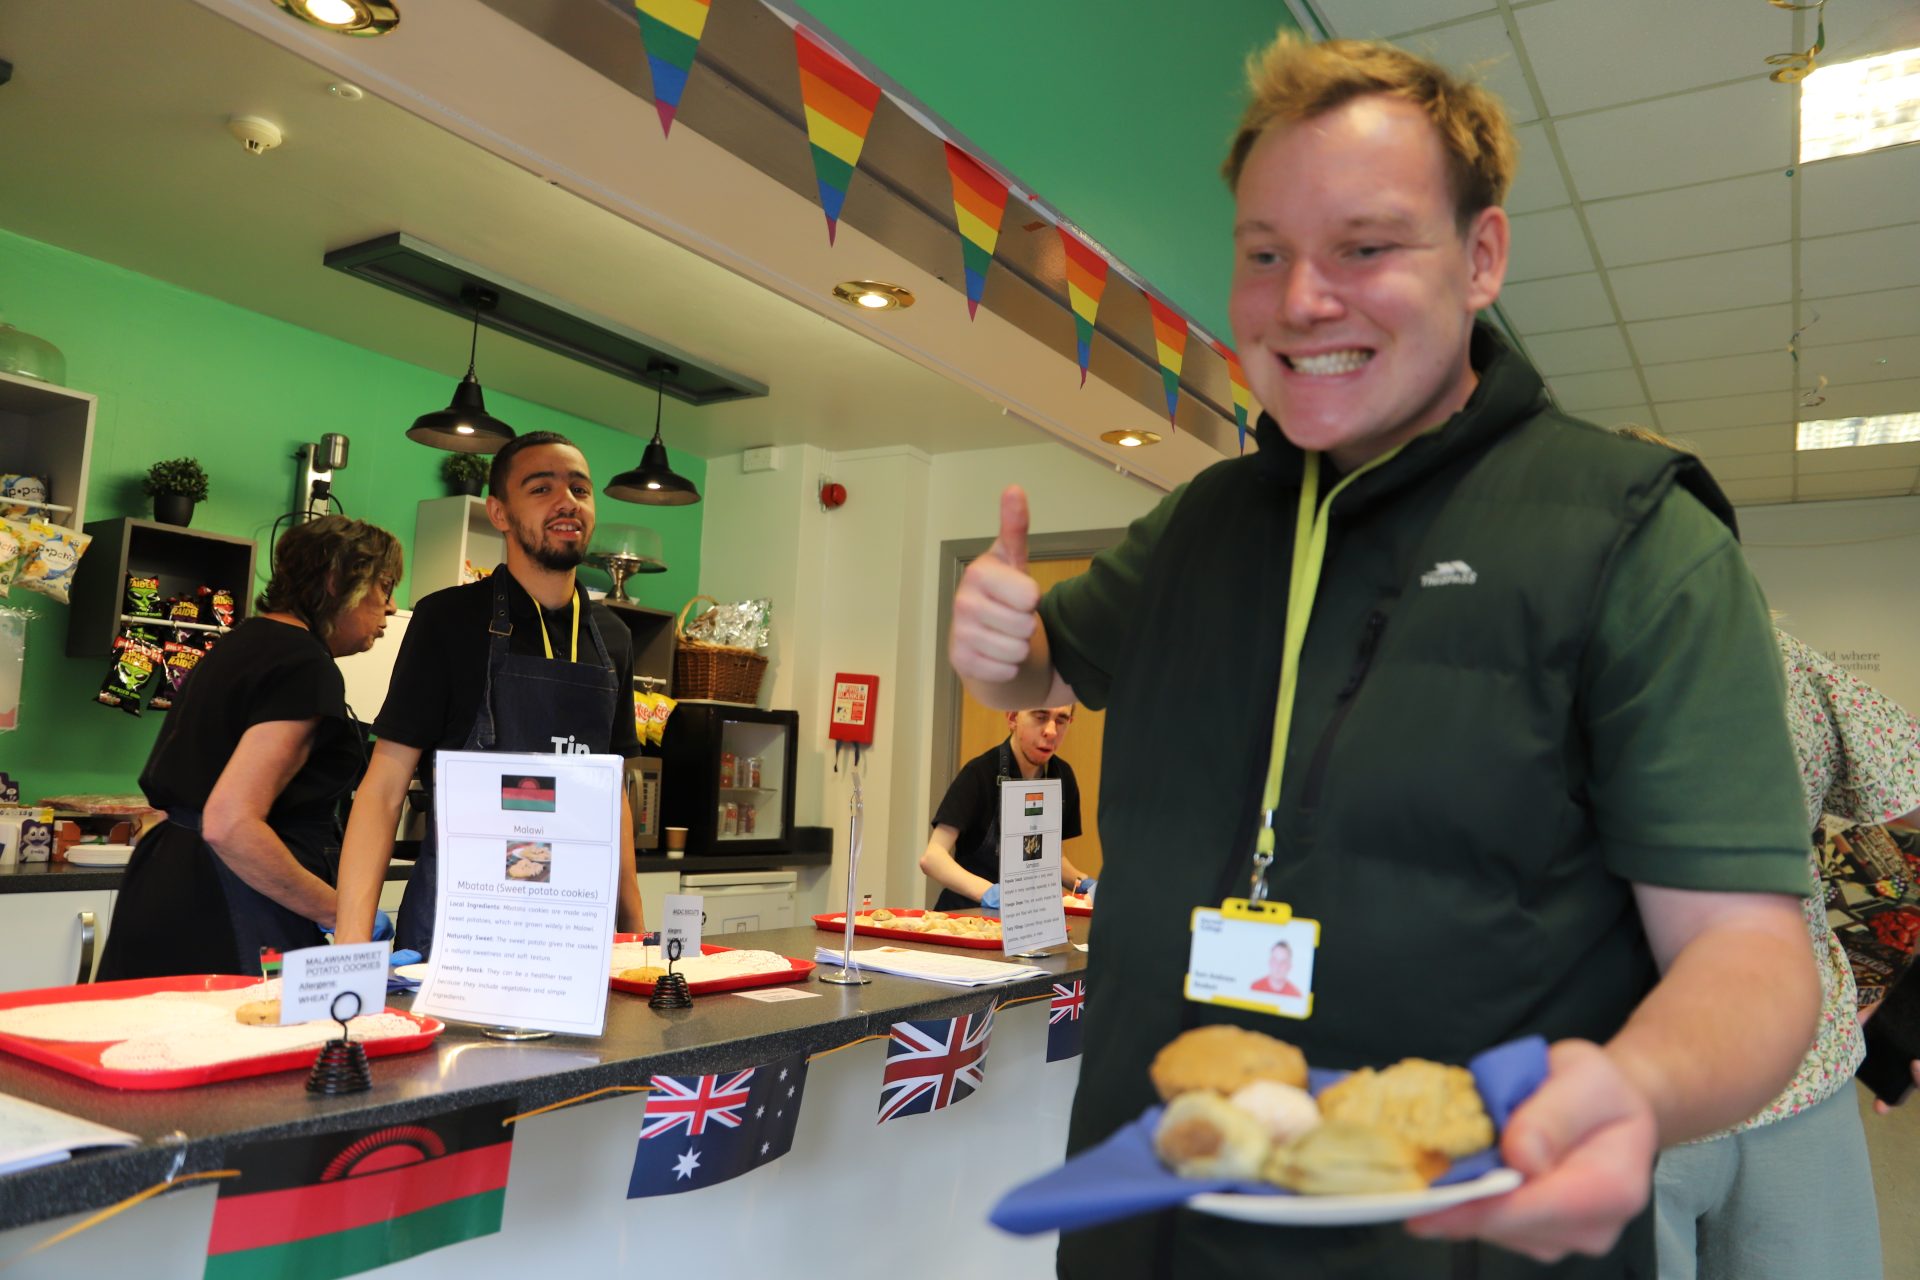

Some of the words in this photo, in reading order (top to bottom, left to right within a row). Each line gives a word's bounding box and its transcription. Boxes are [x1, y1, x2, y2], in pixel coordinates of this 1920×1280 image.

[1840, 650, 1880, 661] where
[513, 825, 545, 835] Malawi
[457, 881, 495, 892] Mbatata
[496, 883, 526, 895] (Sweet
[528, 885, 559, 897] potato
[561, 887, 599, 899] cookies)
[446, 931, 473, 942] Naturally
[305, 953, 351, 966] MALAWIAN
[352, 950, 382, 962] SWEET
[305, 963, 340, 976] POTATO
[342, 960, 381, 973] COOKIES
[441, 963, 463, 974] Healthy
[486, 967, 500, 976] They
[298, 993, 330, 1005] WHEAT
